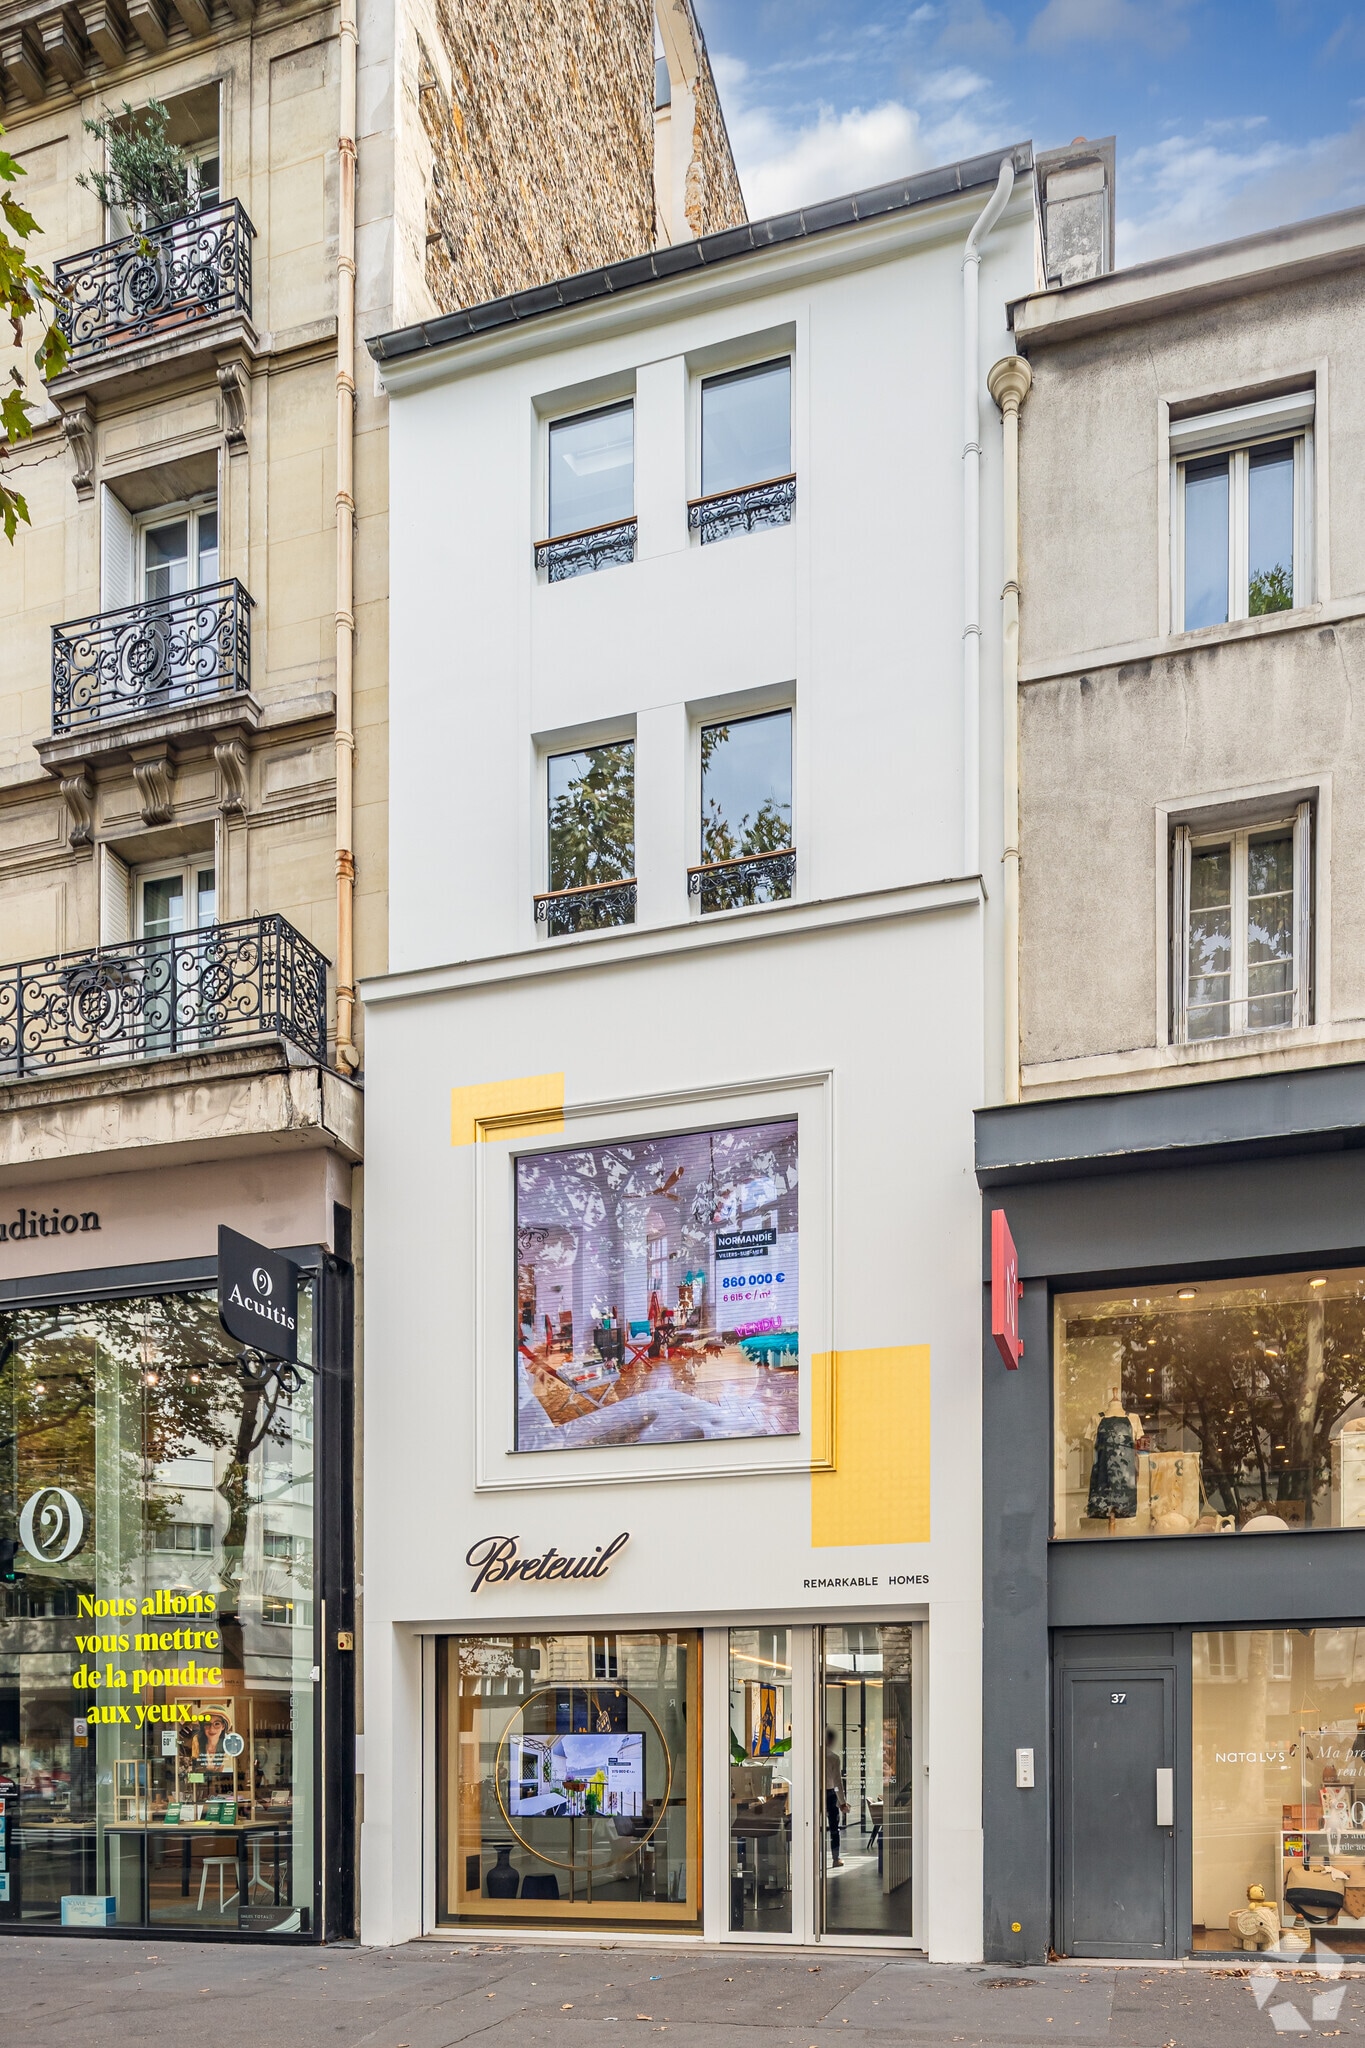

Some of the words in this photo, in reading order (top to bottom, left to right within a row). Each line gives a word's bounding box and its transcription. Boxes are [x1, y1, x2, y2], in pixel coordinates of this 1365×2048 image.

[718, 1232, 773, 1246] NORMANDIE
[722, 1276, 746, 1288] 860
[749, 1273, 773, 1285] 000
[776, 1272, 786, 1283] €
[228, 1283, 295, 1330] Acuitis
[735, 1316, 782, 1337] VENDU
[465, 1531, 630, 1593] Breteuil
[803, 1576, 879, 1588] REMARKABLE
[888, 1574, 930, 1585] HOMES
[77, 1594, 137, 1618] Nous
[141, 1589, 216, 1616] allons
[75, 1633, 130, 1654] vous
[134, 1627, 219, 1651] mettre
[72, 1664, 101, 1689] de
[106, 1663, 128, 1688] la
[132, 1660, 222, 1694] poudre
[1111, 1693, 1126, 1704] 37
[86, 1705, 131, 1724] aux
[134, 1703, 212, 1730] yeux...
[1316, 1746, 1340, 1759] Ma
